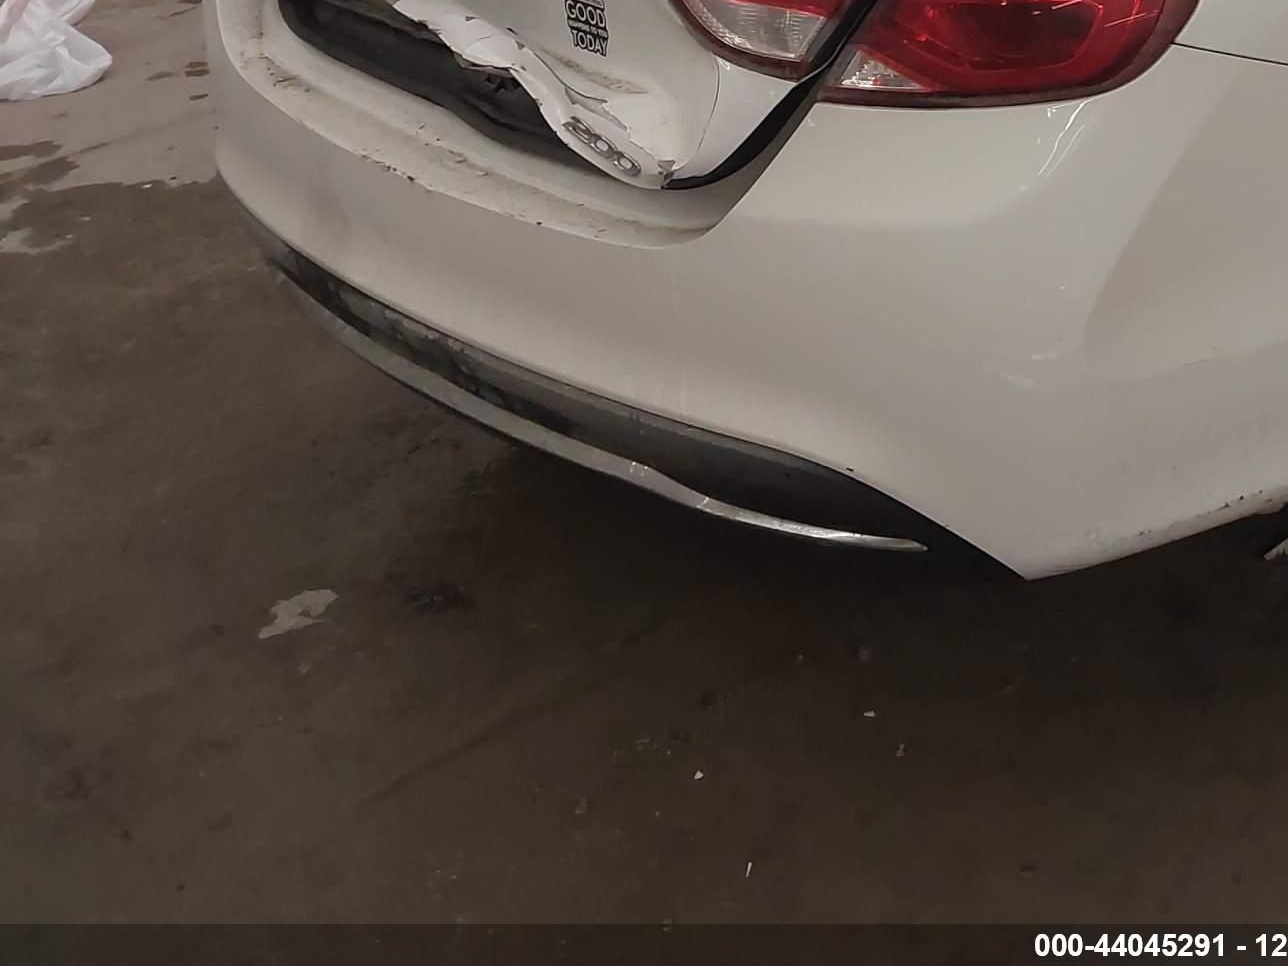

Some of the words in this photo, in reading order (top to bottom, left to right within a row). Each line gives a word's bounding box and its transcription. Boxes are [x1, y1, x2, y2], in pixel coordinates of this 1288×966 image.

[565, 0, 605, 28] GOOD
[572, 29, 608, 56] TODAY
[562, 115, 642, 176] 200
